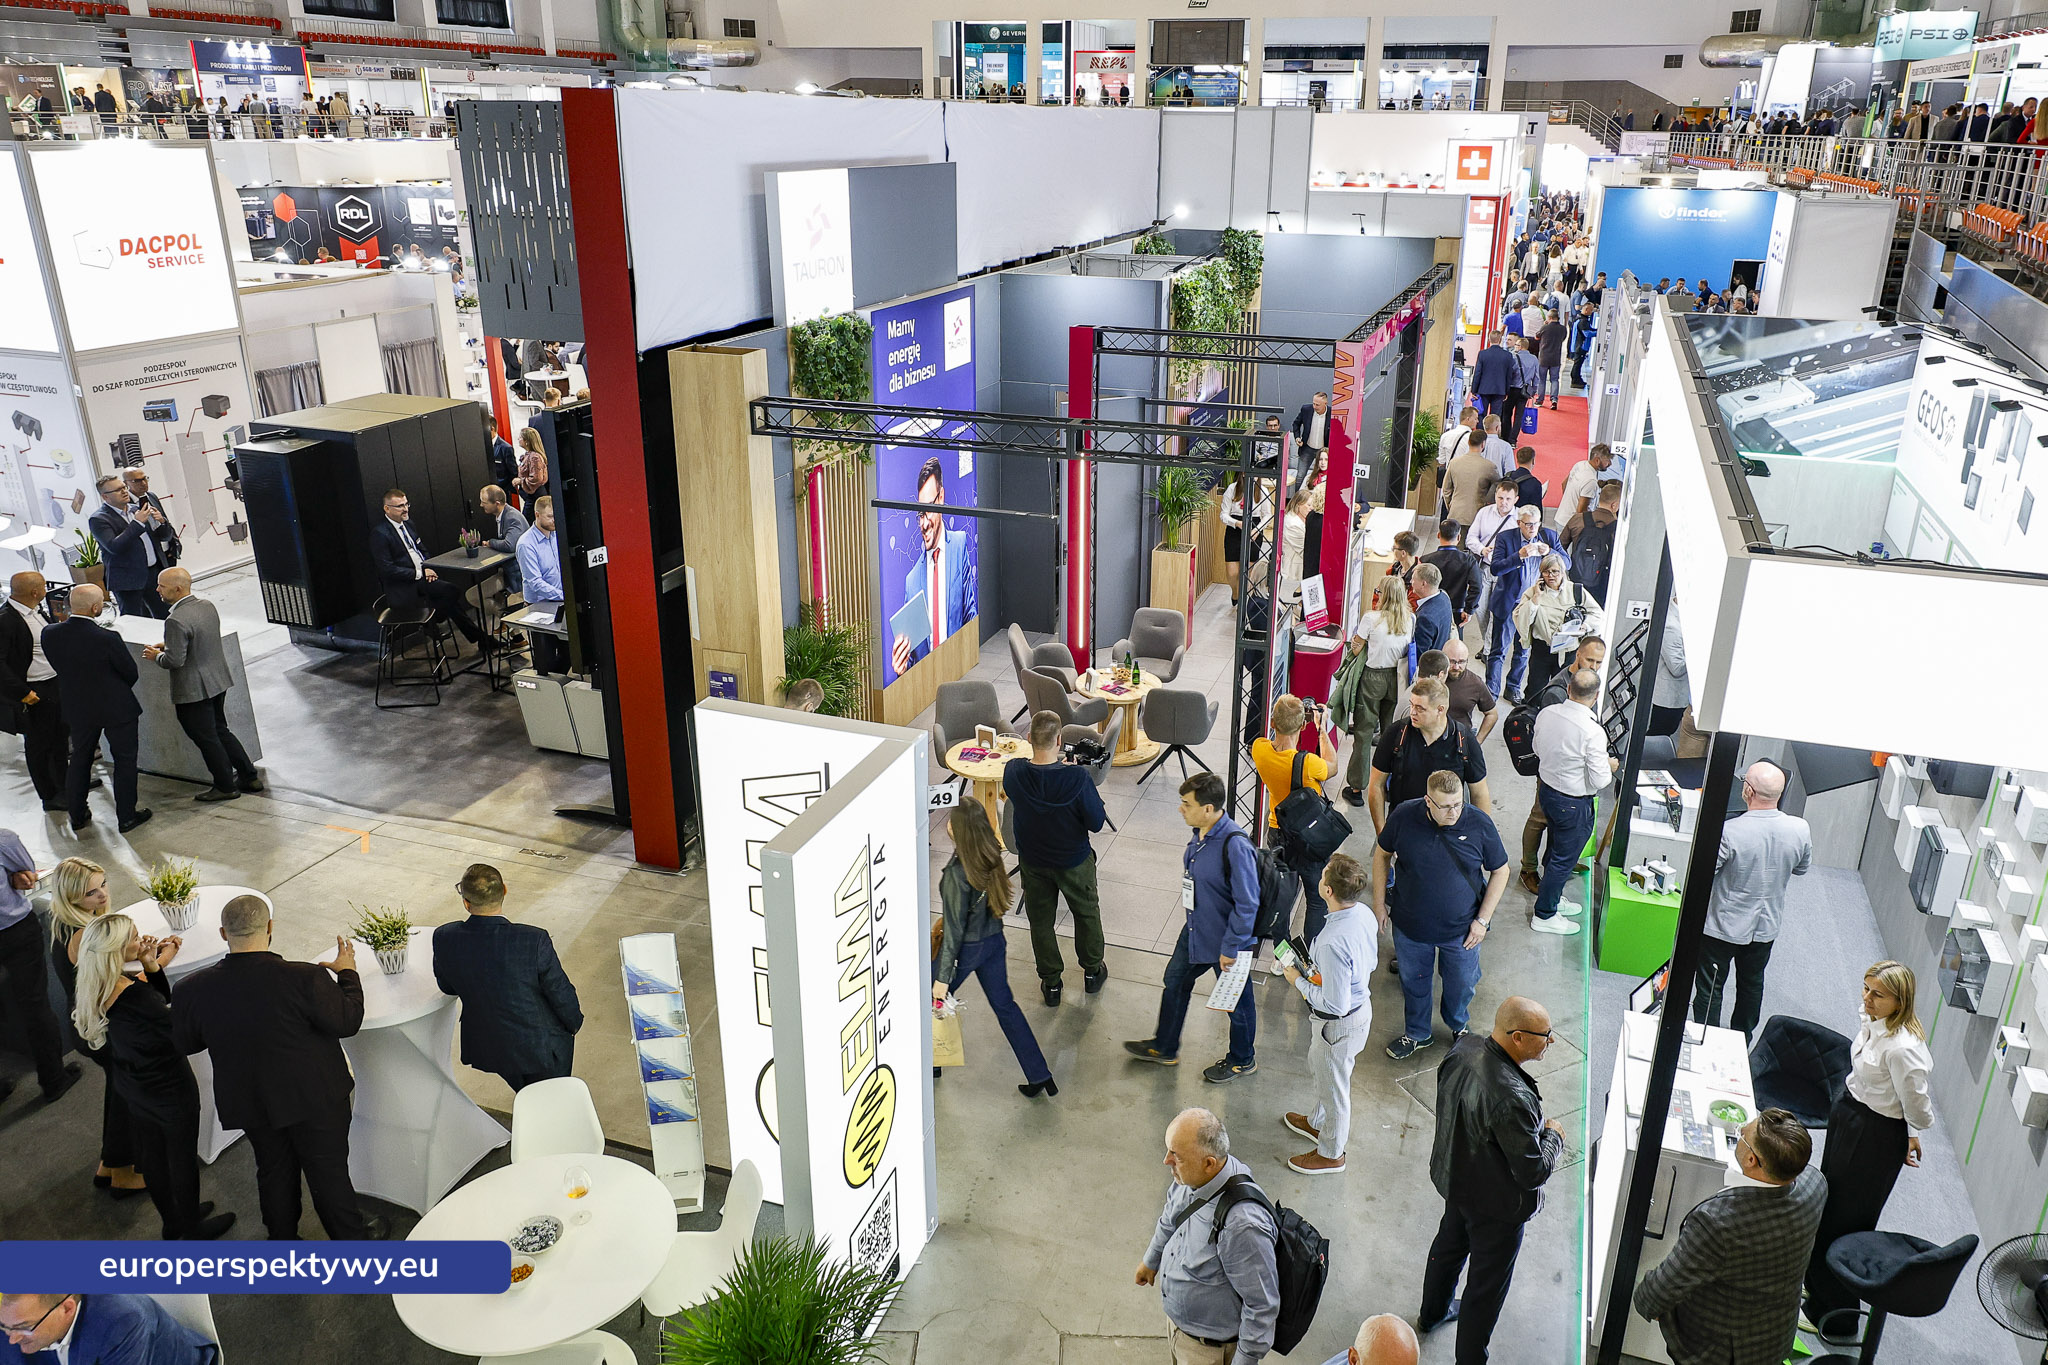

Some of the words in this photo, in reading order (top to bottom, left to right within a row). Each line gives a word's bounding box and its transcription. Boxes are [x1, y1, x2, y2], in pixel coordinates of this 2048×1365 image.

[1879, 30, 1896, 45] PSI
[1910, 29, 1949, 40] PSI
[209, 62, 241, 70] PRODUCENT
[339, 208, 368, 220] RDL
[1677, 207, 1728, 218] finder
[119, 233, 203, 256] DACPOL
[147, 253, 205, 269] SERVICE
[792, 255, 845, 282] TAURON
[887, 318, 915, 340] Mamy
[888, 340, 921, 367] energię
[143, 360, 187, 374] PODZESPOŁY
[92, 385, 105, 393] DO
[105, 382, 124, 391] SZAF
[124, 371, 180, 389] ROZDZIELCZYCH
[184, 361, 238, 378] STEROWNICZYCH
[889, 372, 904, 393] dla
[904, 363, 936, 388] biznesu
[7, 383, 58, 395] CZĘSTOTLIWOŚCI
[1609, 387, 1619, 395] 53
[1917, 389, 1948, 441] GEOS
[1354, 468, 1366, 477] 50
[592, 553, 604, 564] 48
[1632, 607, 1648, 618] 51
[931, 792, 952, 805] 49
[873, 842, 891, 1044] ENERGIA
[834, 844, 875, 1096] ELMA
